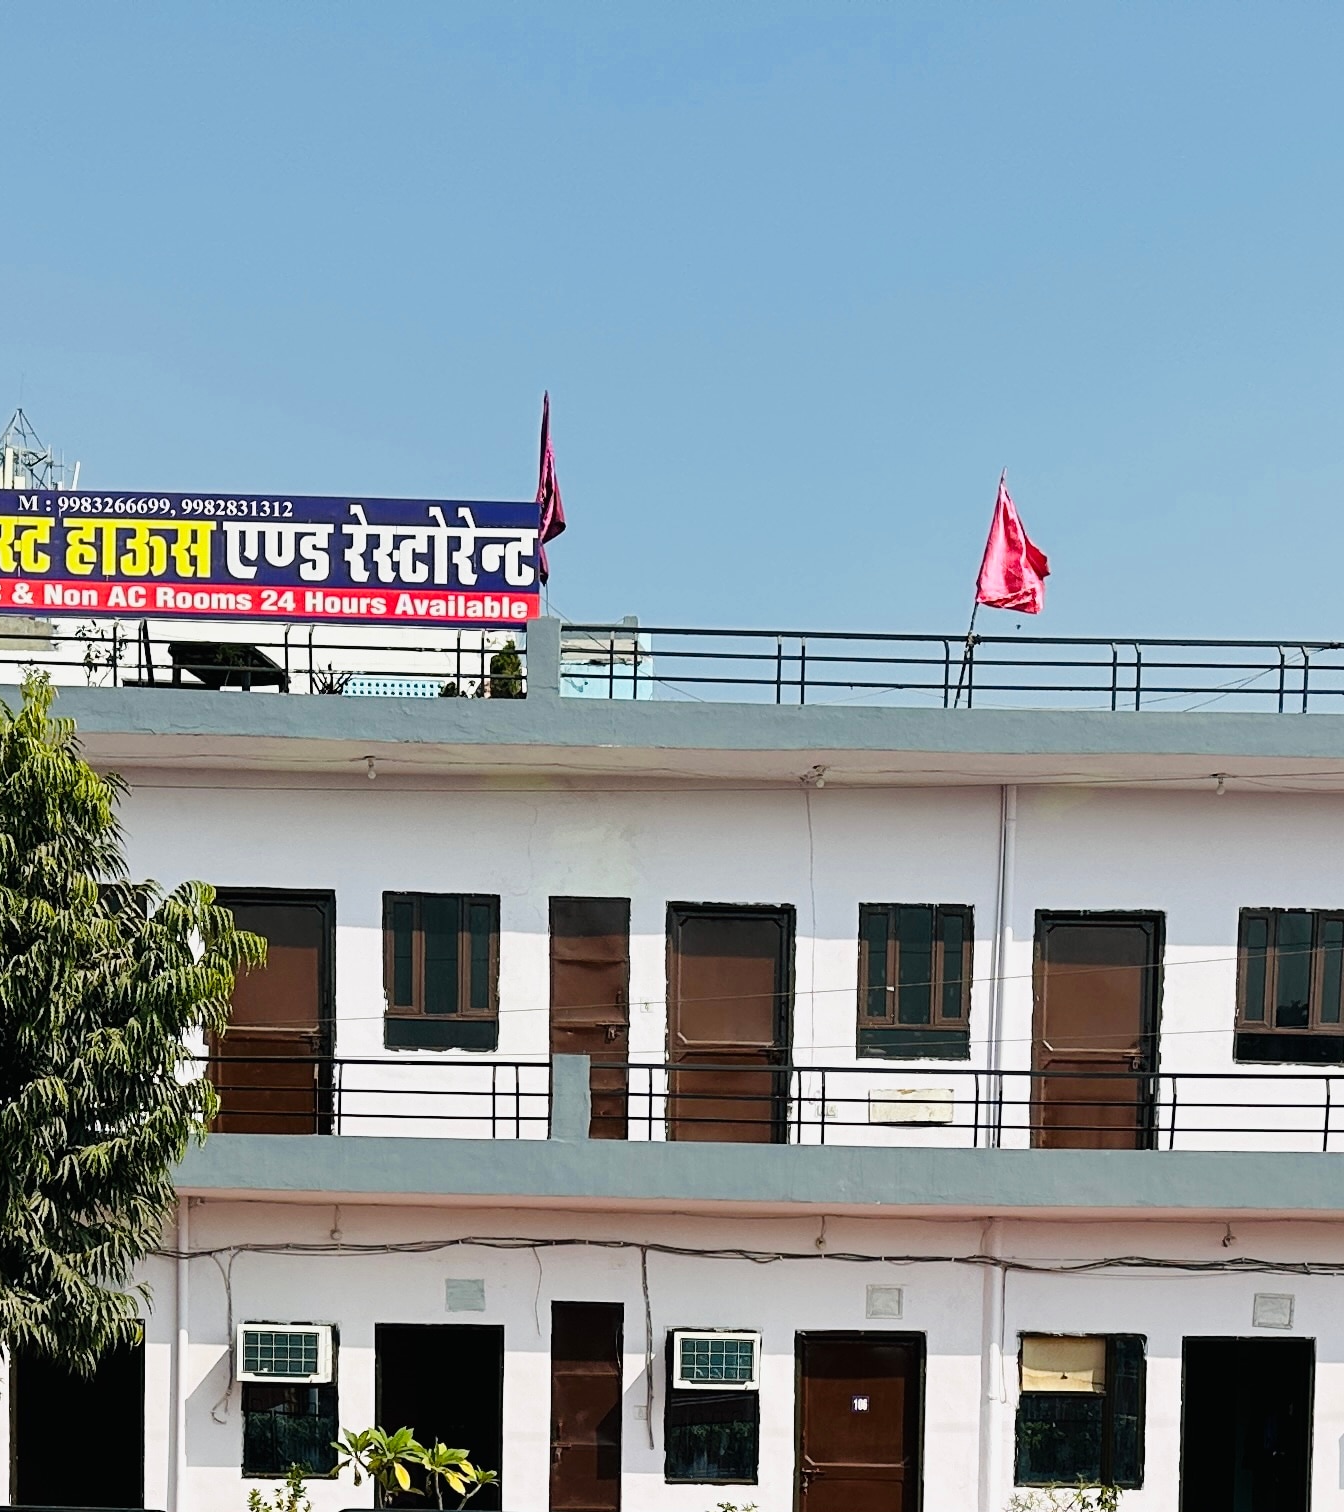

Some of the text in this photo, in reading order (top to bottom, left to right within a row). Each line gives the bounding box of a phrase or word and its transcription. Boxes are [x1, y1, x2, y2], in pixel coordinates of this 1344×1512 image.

[58, 496, 176, 517] 9983266699,
[181, 499, 293, 517] 9982831312
[63, 518, 216, 578] हाऊस
[223, 521, 335, 582] एण्ड
[342, 504, 539, 587] रेस्टोरेन्ट
[11, 582, 34, 605] &
[44, 584, 100, 607] Non
[107, 586, 146, 609] AC
[157, 587, 252, 611] Rooms
[260, 589, 295, 612] 24
[305, 591, 387, 616] Hours
[394, 592, 528, 619] Available
